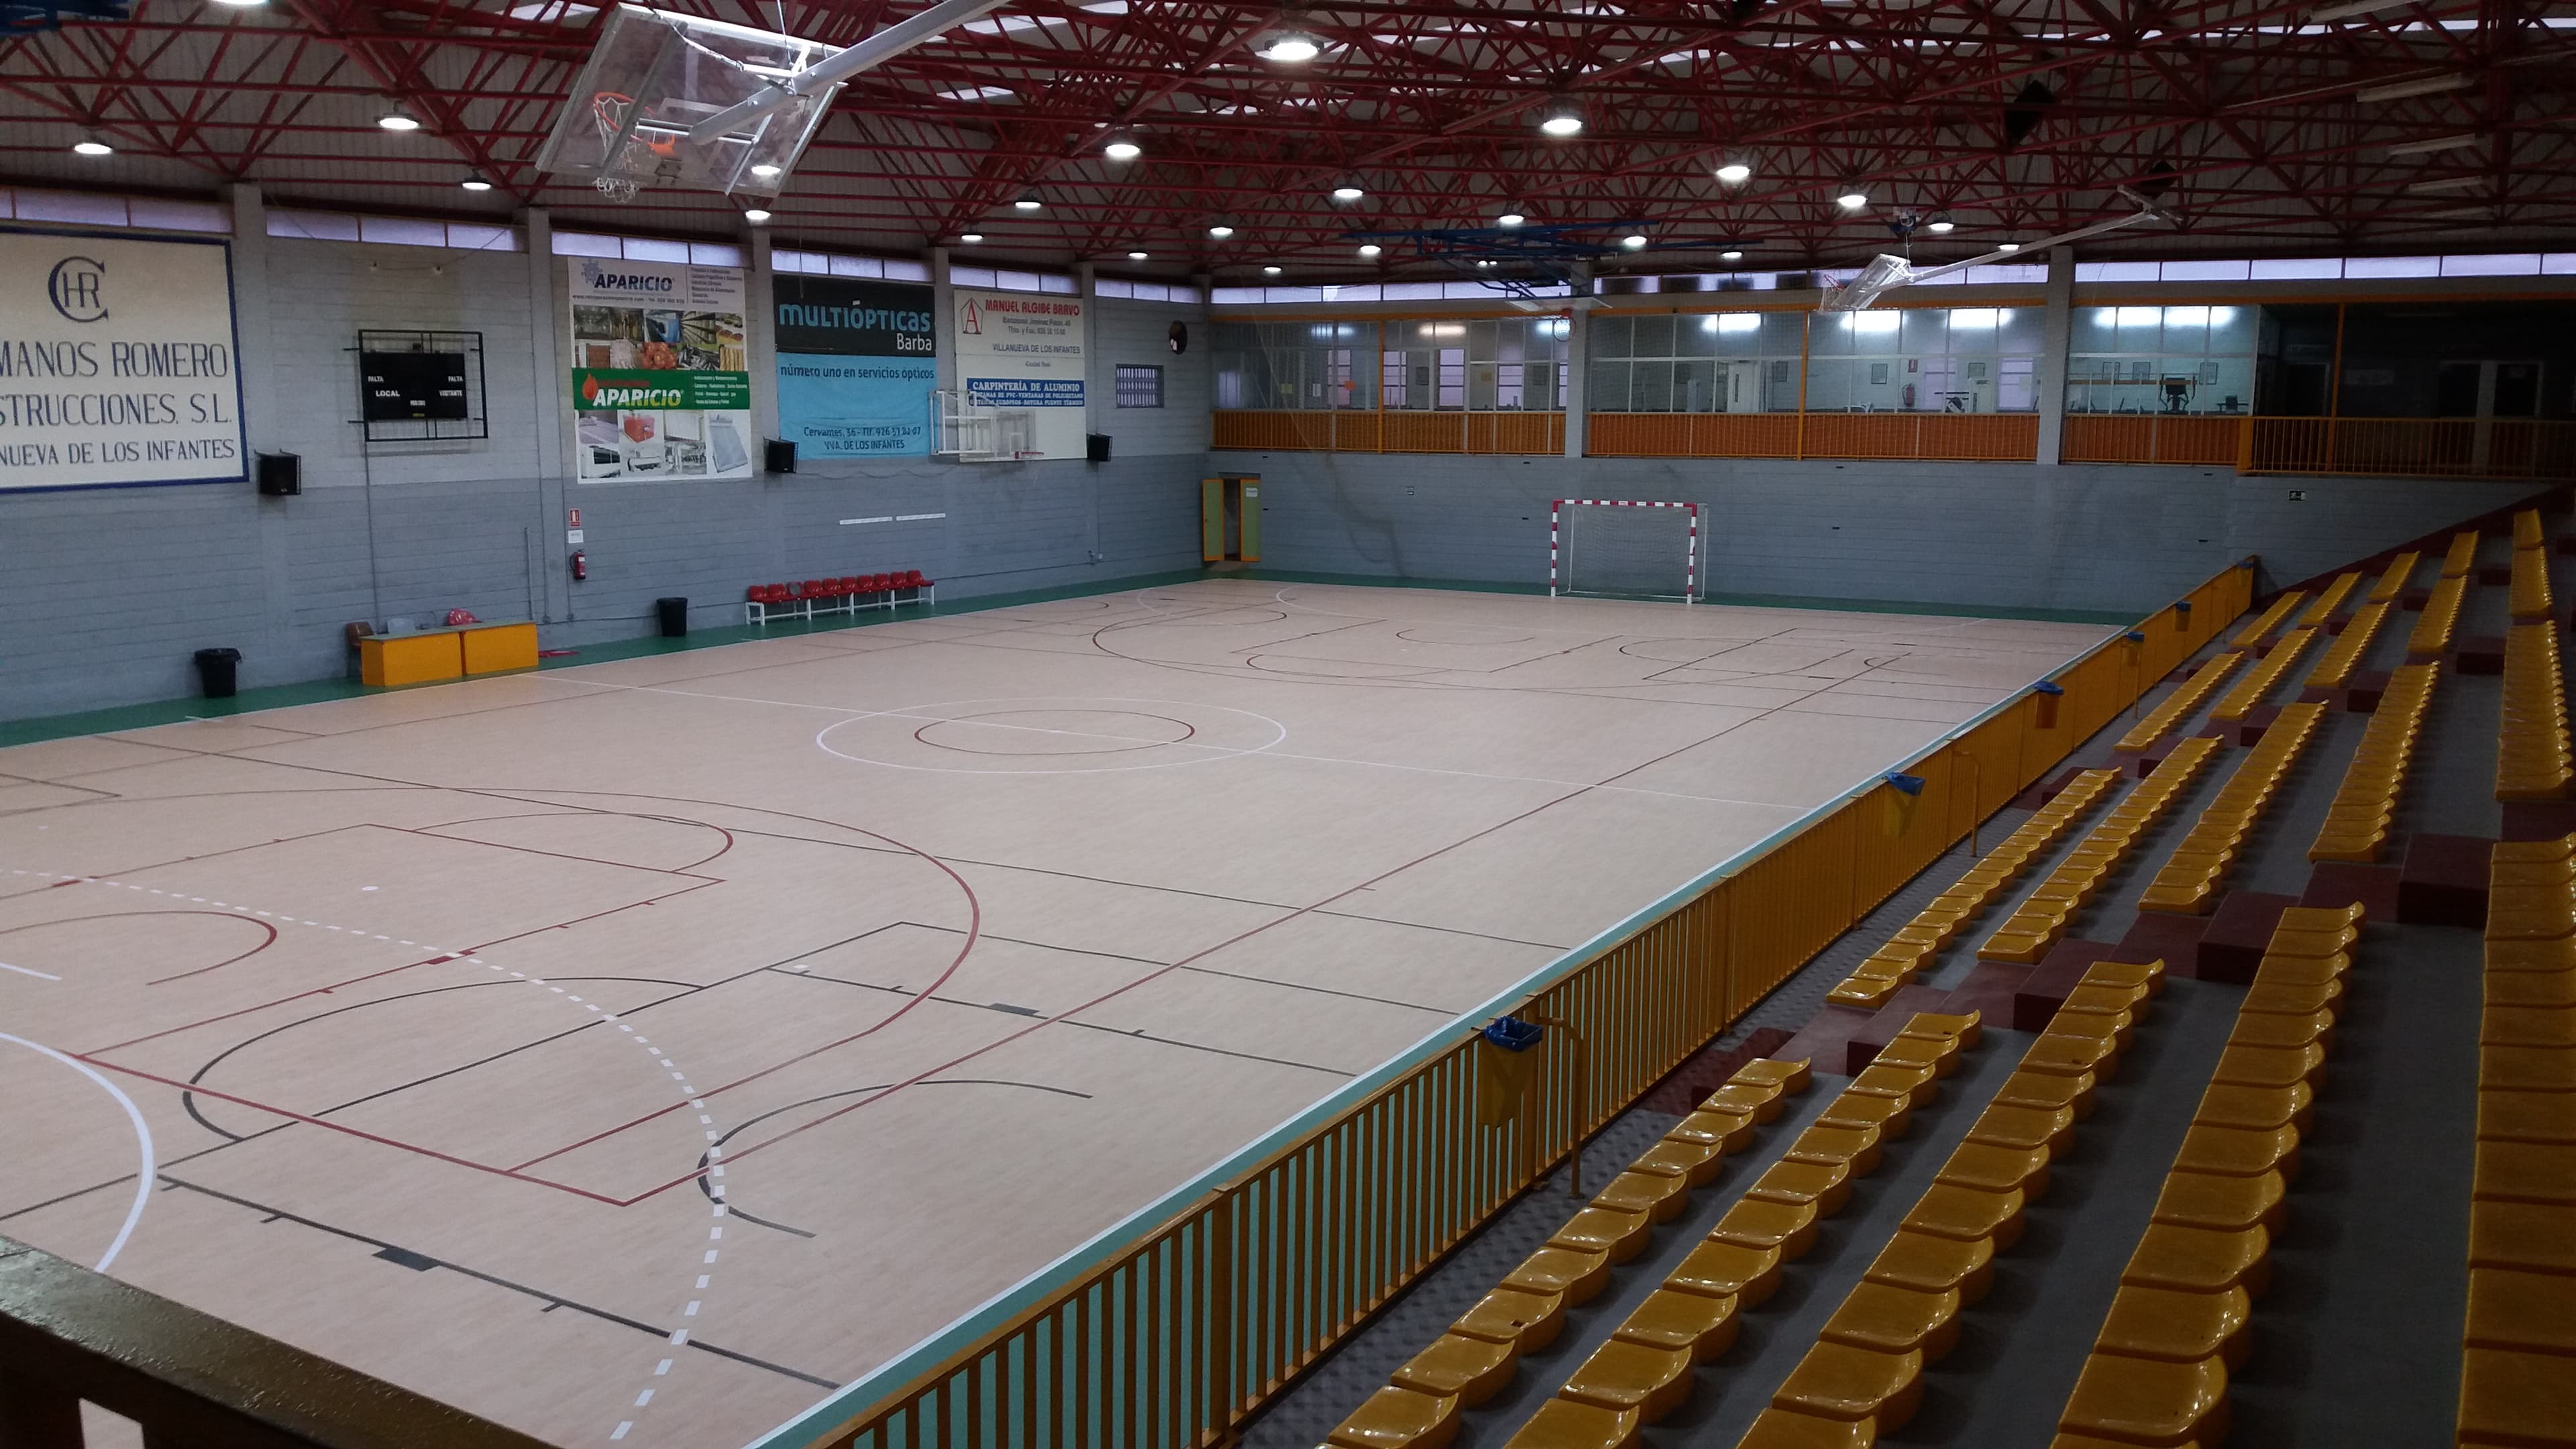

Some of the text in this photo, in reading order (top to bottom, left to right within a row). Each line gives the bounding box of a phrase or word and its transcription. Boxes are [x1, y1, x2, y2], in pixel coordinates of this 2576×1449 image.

[594, 273, 672, 292] APARICIO
[985, 299, 1080, 316] MANUEL ALGIBE BRAVO
[896, 333, 932, 351] Barba
[992, 343, 1081, 354] VILLANUEVA DE LOS INFANTES
[111, 341, 227, 377] ROMERO
[781, 364, 820, 377] número
[822, 368, 841, 378] uno
[844, 370, 855, 378] en
[858, 366, 900, 379] servicios
[973, 380, 1080, 392] CARPINTERÍA DE ALUMINIO
[592, 388, 682, 407] APARICIO
[190, 393, 232, 424] S.L.
[804, 427, 845, 438] Cervantes,
[876, 426, 890, 436] 926
[912, 427, 921, 435] 07
[68, 442, 94, 464] DE
[102, 441, 140, 463] LOS
[146, 438, 235, 462] INFANTES
[844, 441, 853, 450] DE
[855, 440, 869, 449] LOS
[870, 439, 905, 449] INFANTES
